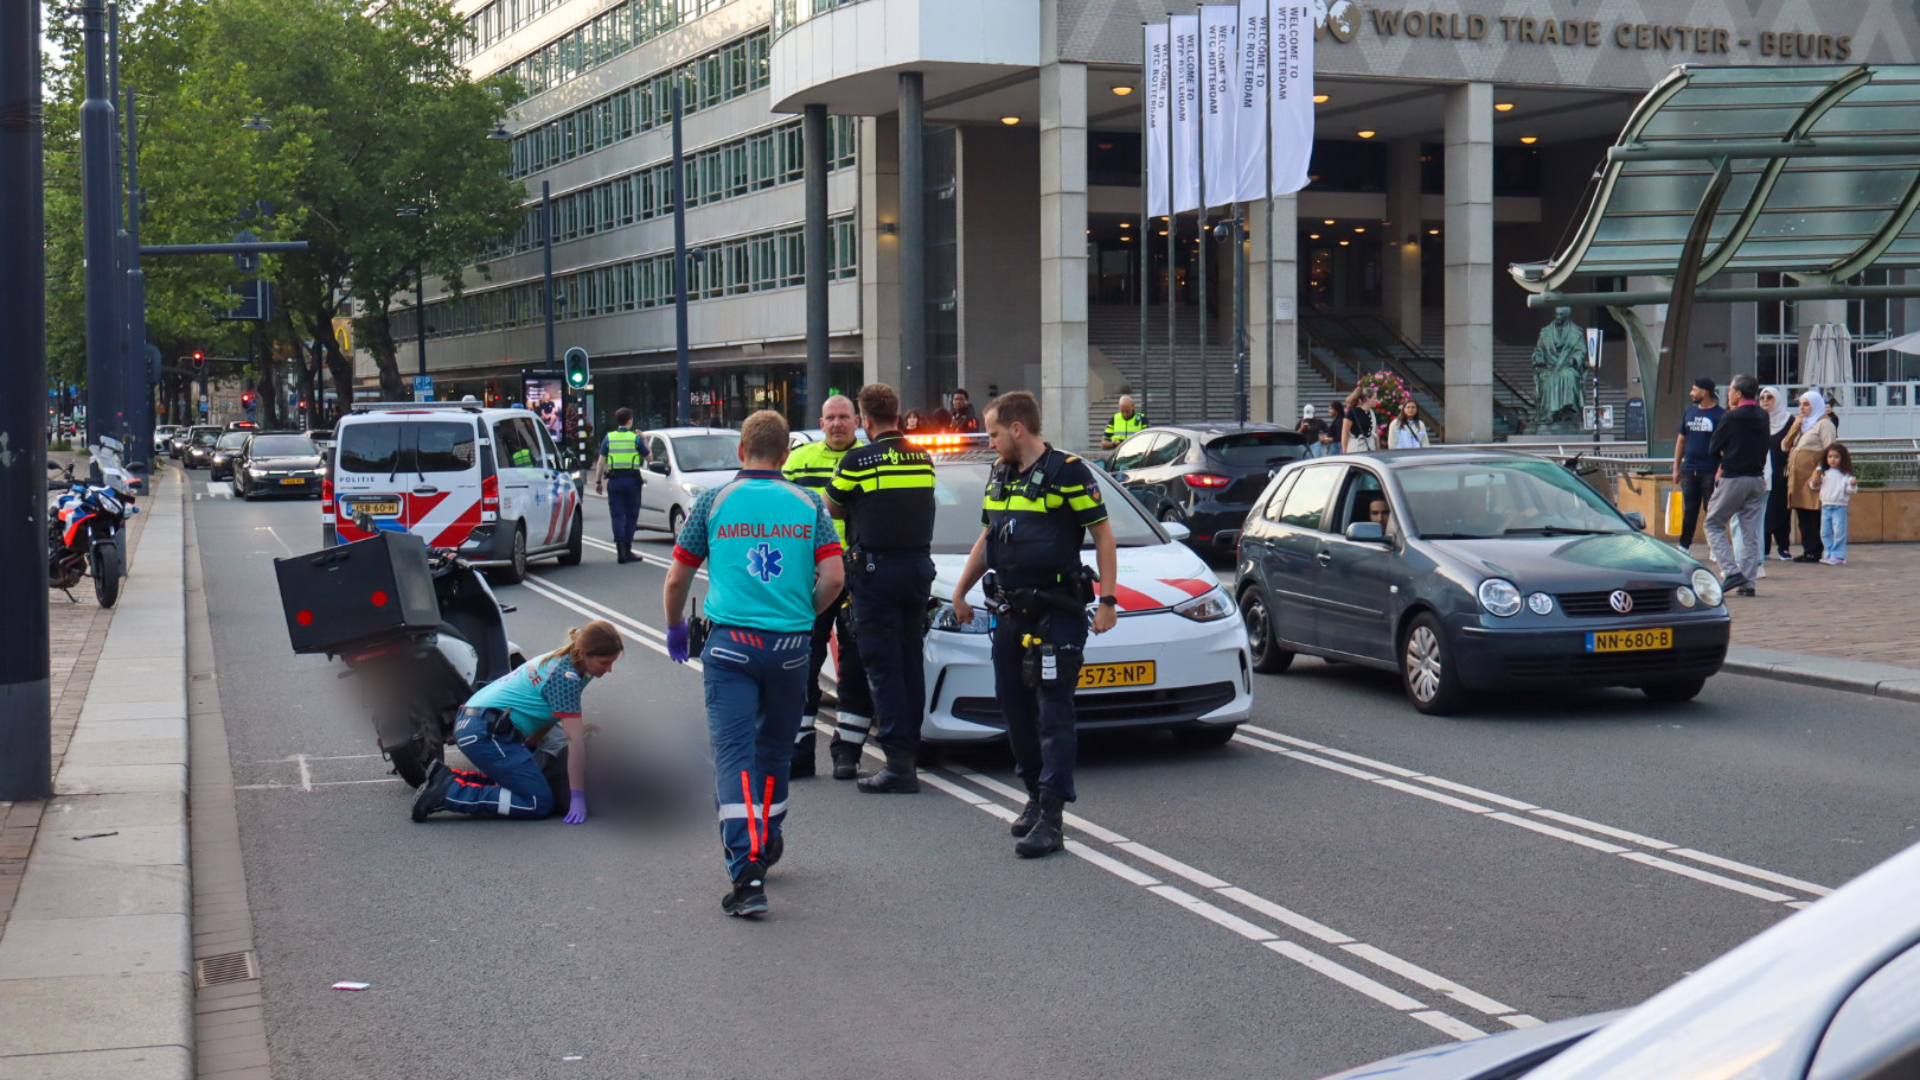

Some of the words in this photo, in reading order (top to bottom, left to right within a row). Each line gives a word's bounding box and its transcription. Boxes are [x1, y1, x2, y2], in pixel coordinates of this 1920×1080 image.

[1209, 25, 1217, 48] WTC
[1246, 17, 1256, 40] WTC
[1278, 7, 1287, 31] WTC
[1289, 7, 1299, 61] WELCOME
[1372, 8, 1488, 40] WORLD
[1500, 15, 1602, 48] TRADE
[1614, 23, 1731, 54] CENTER
[1760, 31, 1851, 60] BEURS
[1186, 34, 1195, 84] WELCOME
[1218, 25, 1227, 75] WELCOME
[1257, 17, 1267, 69] WELCOME
[1159, 44, 1169, 92] WELCOME
[1208, 51, 1218, 115] ROTTERDAM
[1243, 43, 1255, 108] ROTTERDAM
[1256, 73, 1265, 88] TO
[1278, 34, 1287, 100] ROTTERDAM
[1290, 65, 1299, 79] TO
[1150, 69, 1159, 129] ROTTERDAM
[1158, 96, 1165, 109] TO
[1186, 88, 1195, 101] TO
[1218, 79, 1226, 93] TO
[717, 523, 813, 539] AMBULANCE
[1596, 631, 1669, 650] NN-680-B
